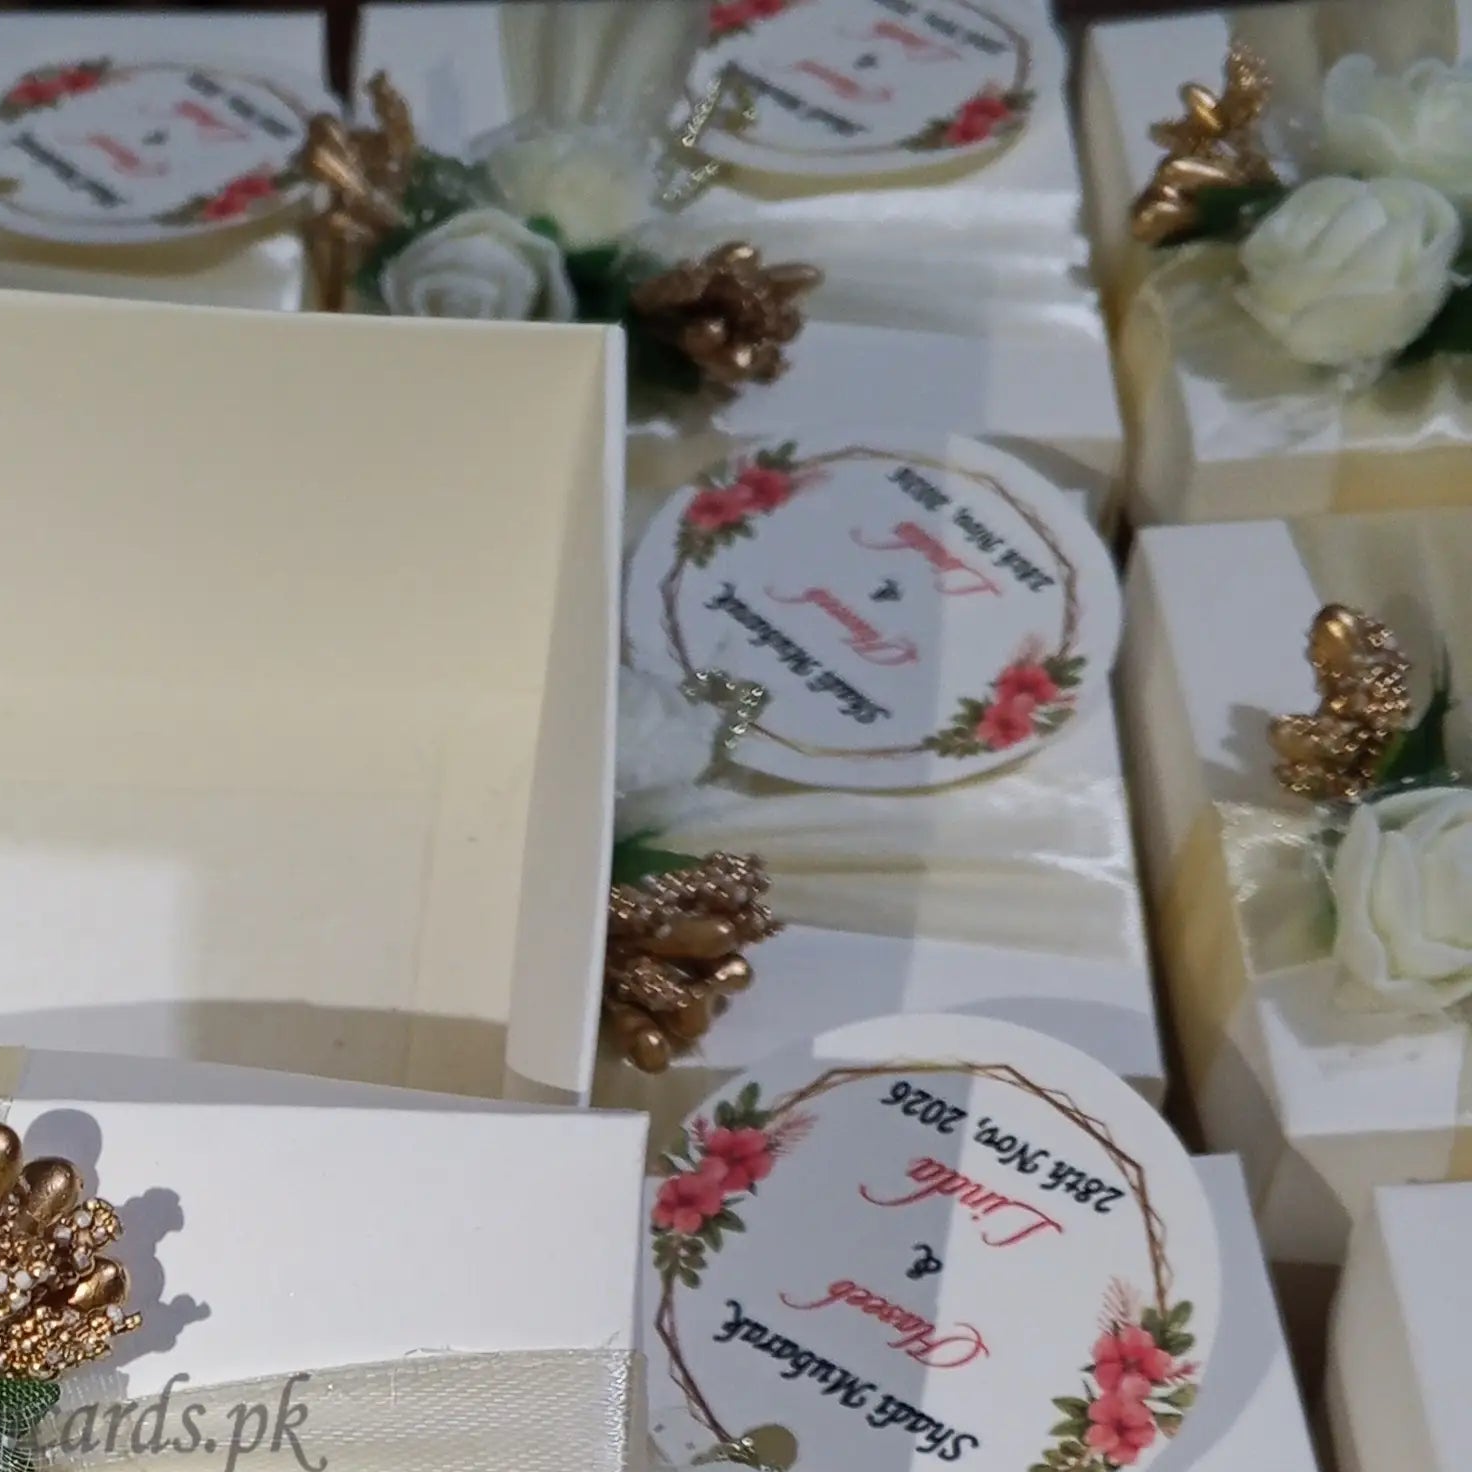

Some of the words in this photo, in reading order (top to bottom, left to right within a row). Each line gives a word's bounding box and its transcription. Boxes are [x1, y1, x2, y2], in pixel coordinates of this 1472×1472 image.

[879, 1081, 967, 1133] 2026
[975, 1118, 1049, 1174] Nov,
[859, 1157, 1064, 1248] Linda
[1040, 1161, 1125, 1213] 28th
[906, 1244, 943, 1279] &
[713, 1300, 867, 1408] Mubarak
[779, 1279, 990, 1368] Haseeb
[866, 1394, 978, 1461] Shadi
